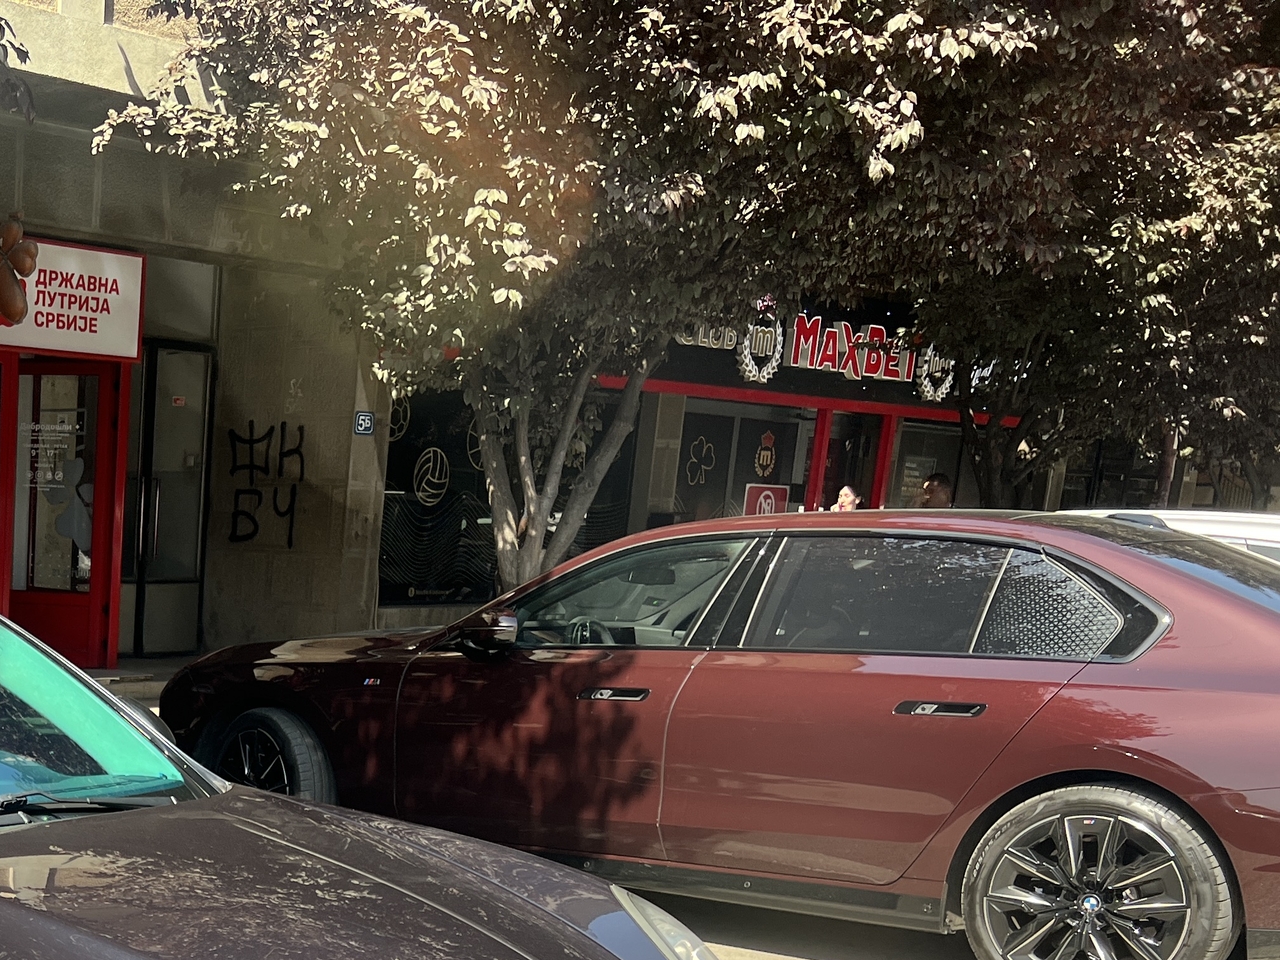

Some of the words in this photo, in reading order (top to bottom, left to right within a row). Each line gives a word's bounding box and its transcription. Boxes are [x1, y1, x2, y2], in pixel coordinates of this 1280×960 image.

[35, 268, 120, 296] ДРЖАВНА
[34, 289, 111, 315] ЛУТРИЈА
[33, 310, 98, 334] СРБИЈЕ
